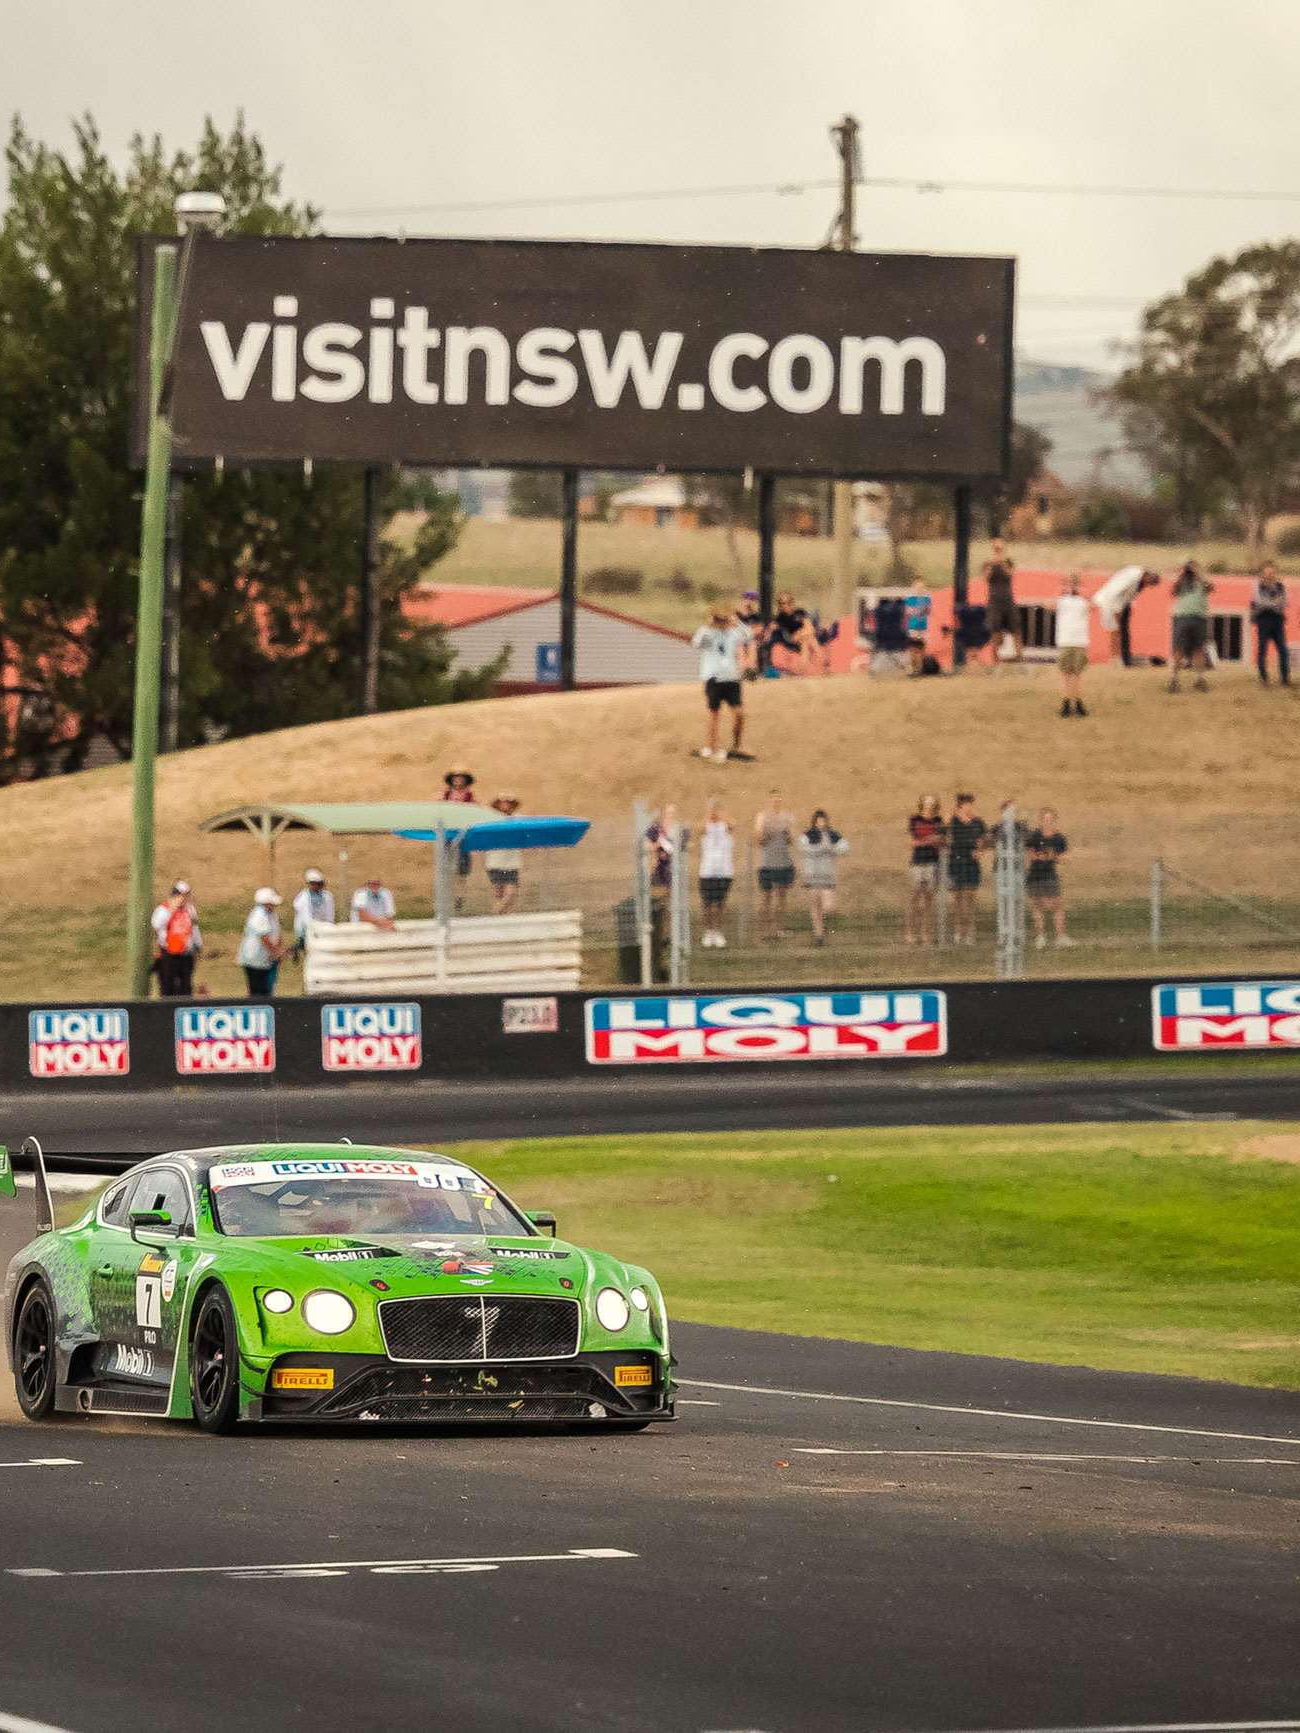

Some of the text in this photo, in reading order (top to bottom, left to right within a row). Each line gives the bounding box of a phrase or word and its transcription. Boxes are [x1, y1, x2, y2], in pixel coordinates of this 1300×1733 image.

[200, 296, 946, 416] visitnsw.com
[182, 1011, 267, 1038] LIQUI
[329, 1008, 413, 1036] LIQUI
[610, 995, 922, 1029] LIQUI
[37, 1014, 121, 1041] LIQUI
[610, 1024, 936, 1057] MOLY
[1178, 1013, 1300, 1044] M
[37, 1043, 125, 1072] MOLY
[182, 1040, 270, 1069] MOLY
[330, 1037, 416, 1066] MOLY
[275, 1163, 412, 1175] LIQUI MOLY
[314, 1250, 357, 1263] Mobil
[497, 1250, 538, 1260] Mobil
[145, 1284, 153, 1325] 7
[144, 1330, 157, 1345] PRO
[115, 1343, 145, 1375] Mobil
[277, 1372, 328, 1385] PIRELLI
